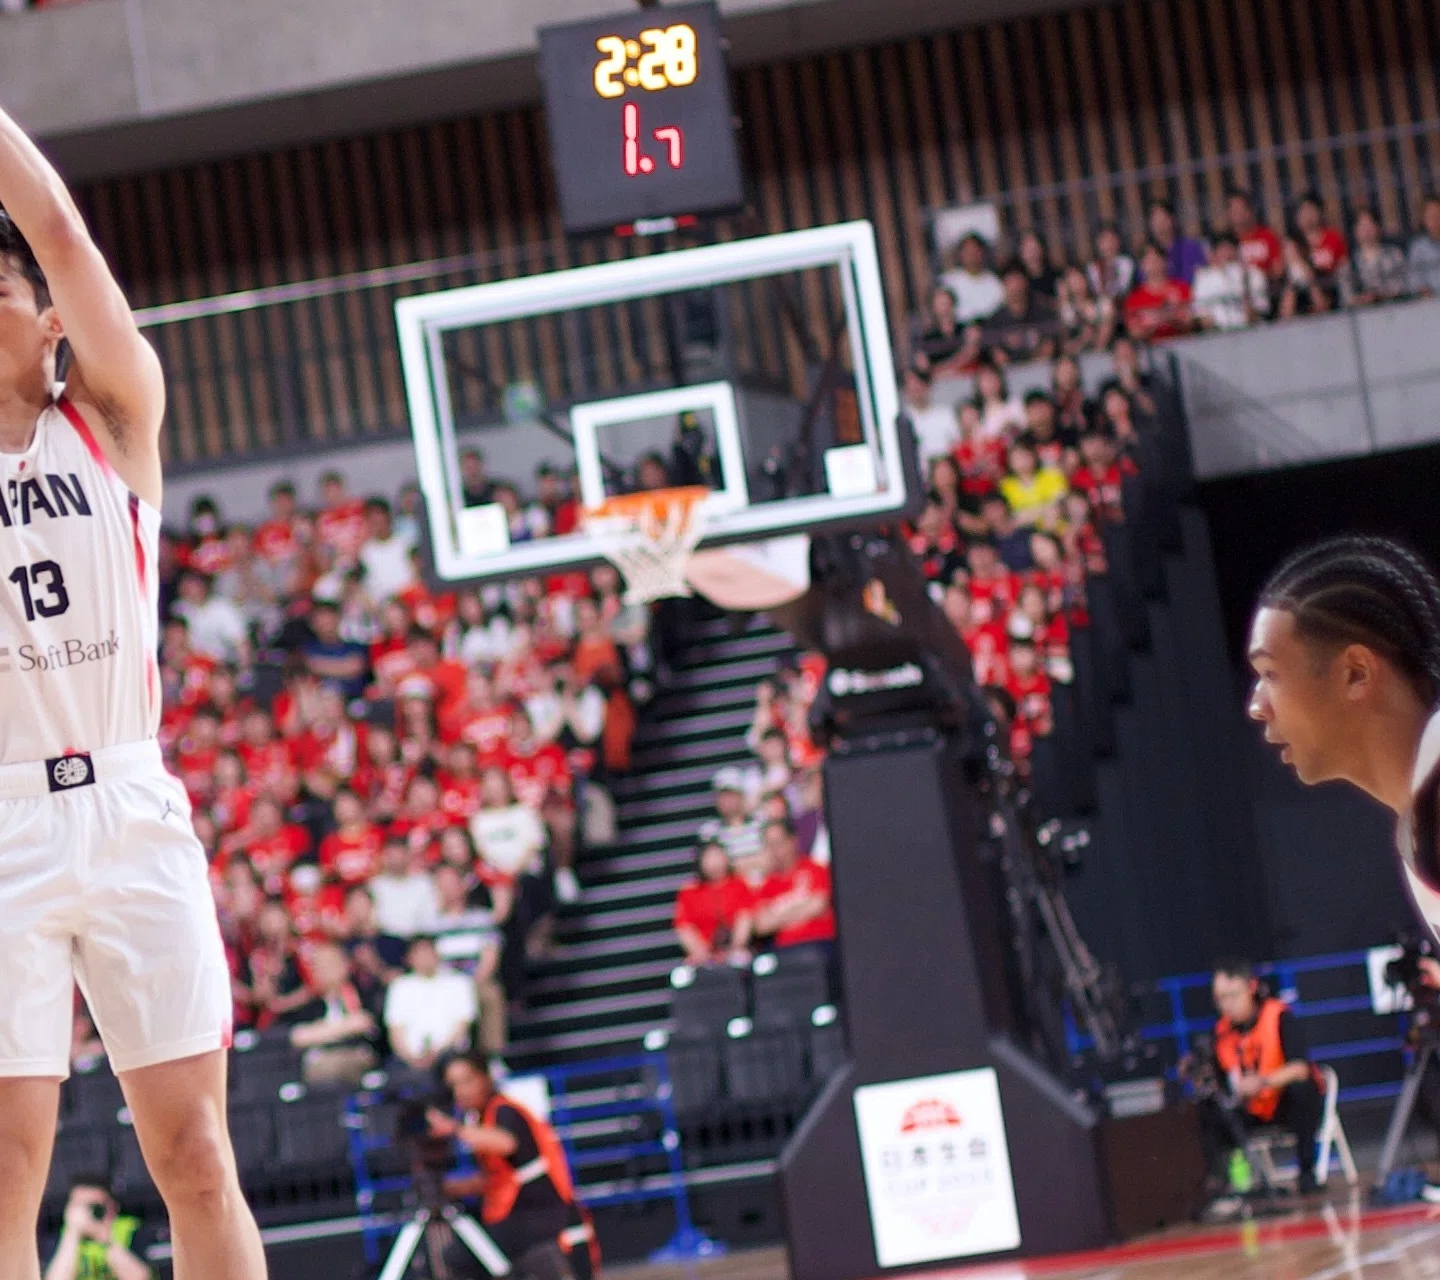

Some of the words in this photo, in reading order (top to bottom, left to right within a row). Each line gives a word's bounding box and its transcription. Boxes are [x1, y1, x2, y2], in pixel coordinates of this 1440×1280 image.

[594, 24, 697, 98] 2:28
[8, 560, 69, 622] 13
[18, 629, 120, 671] SoftBank
